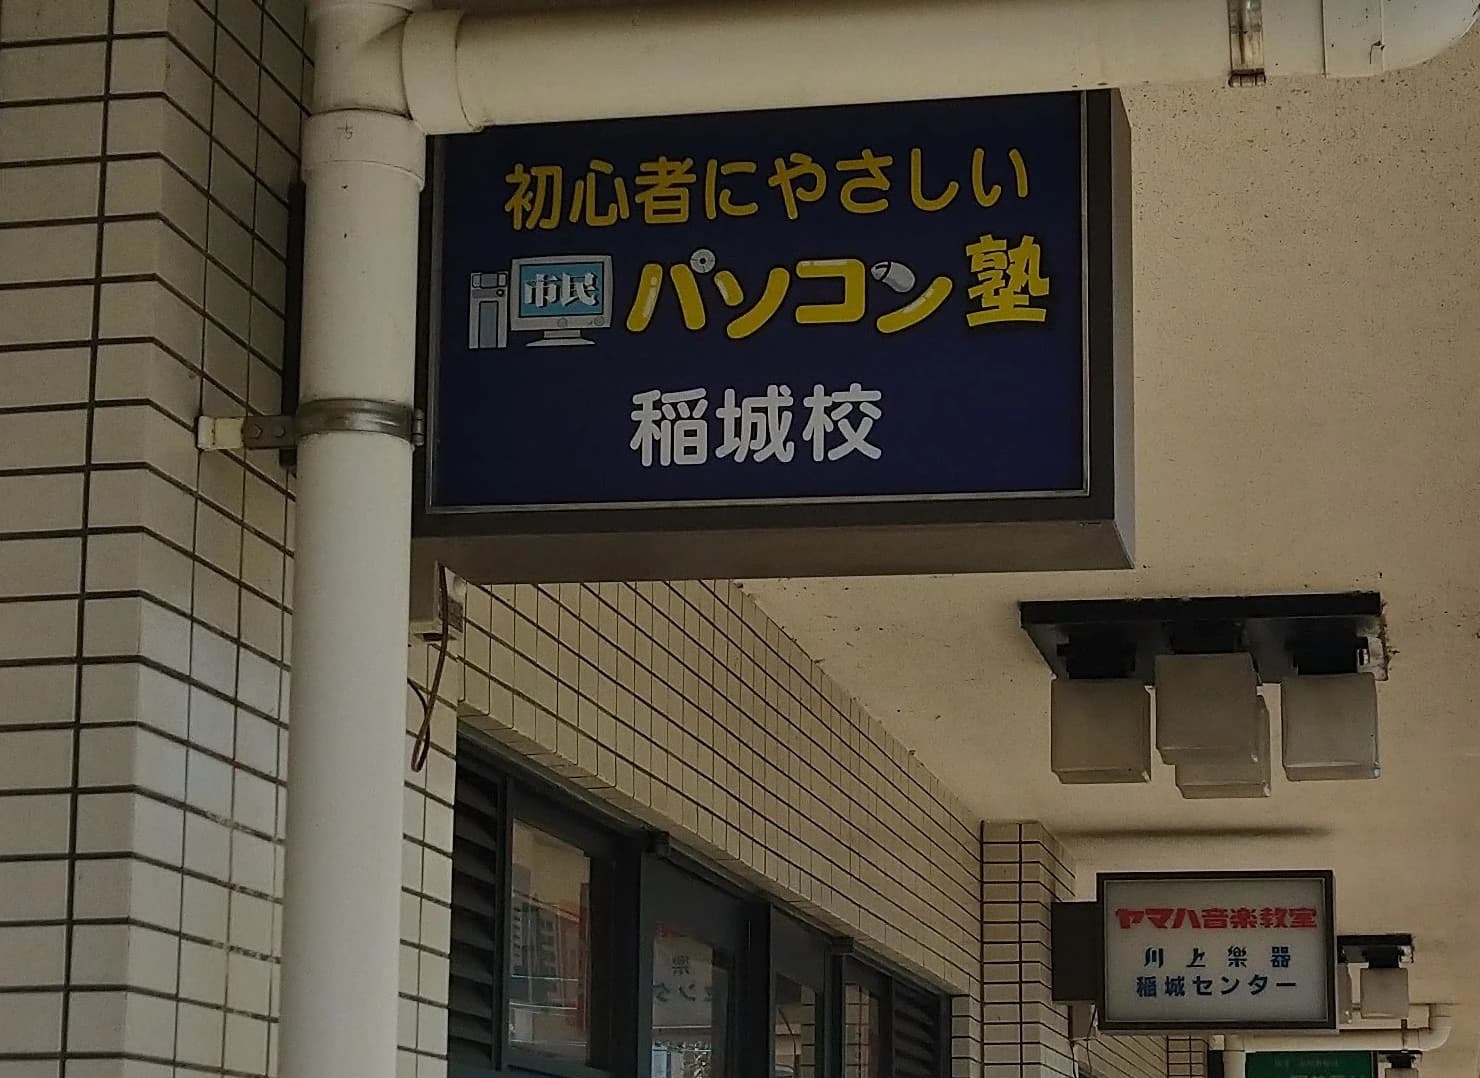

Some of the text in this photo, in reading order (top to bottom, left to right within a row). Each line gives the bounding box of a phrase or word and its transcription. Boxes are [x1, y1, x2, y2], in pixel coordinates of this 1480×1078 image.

[504, 148, 1029, 230] 初心者にやさしい
[525, 235, 1050, 338] 市民 パソコン塾
[629, 383, 883, 467] 稲城校
[1115, 908, 1318, 930] ヤマハ音楽教室
[1136, 974, 1297, 998] 稲城センター
